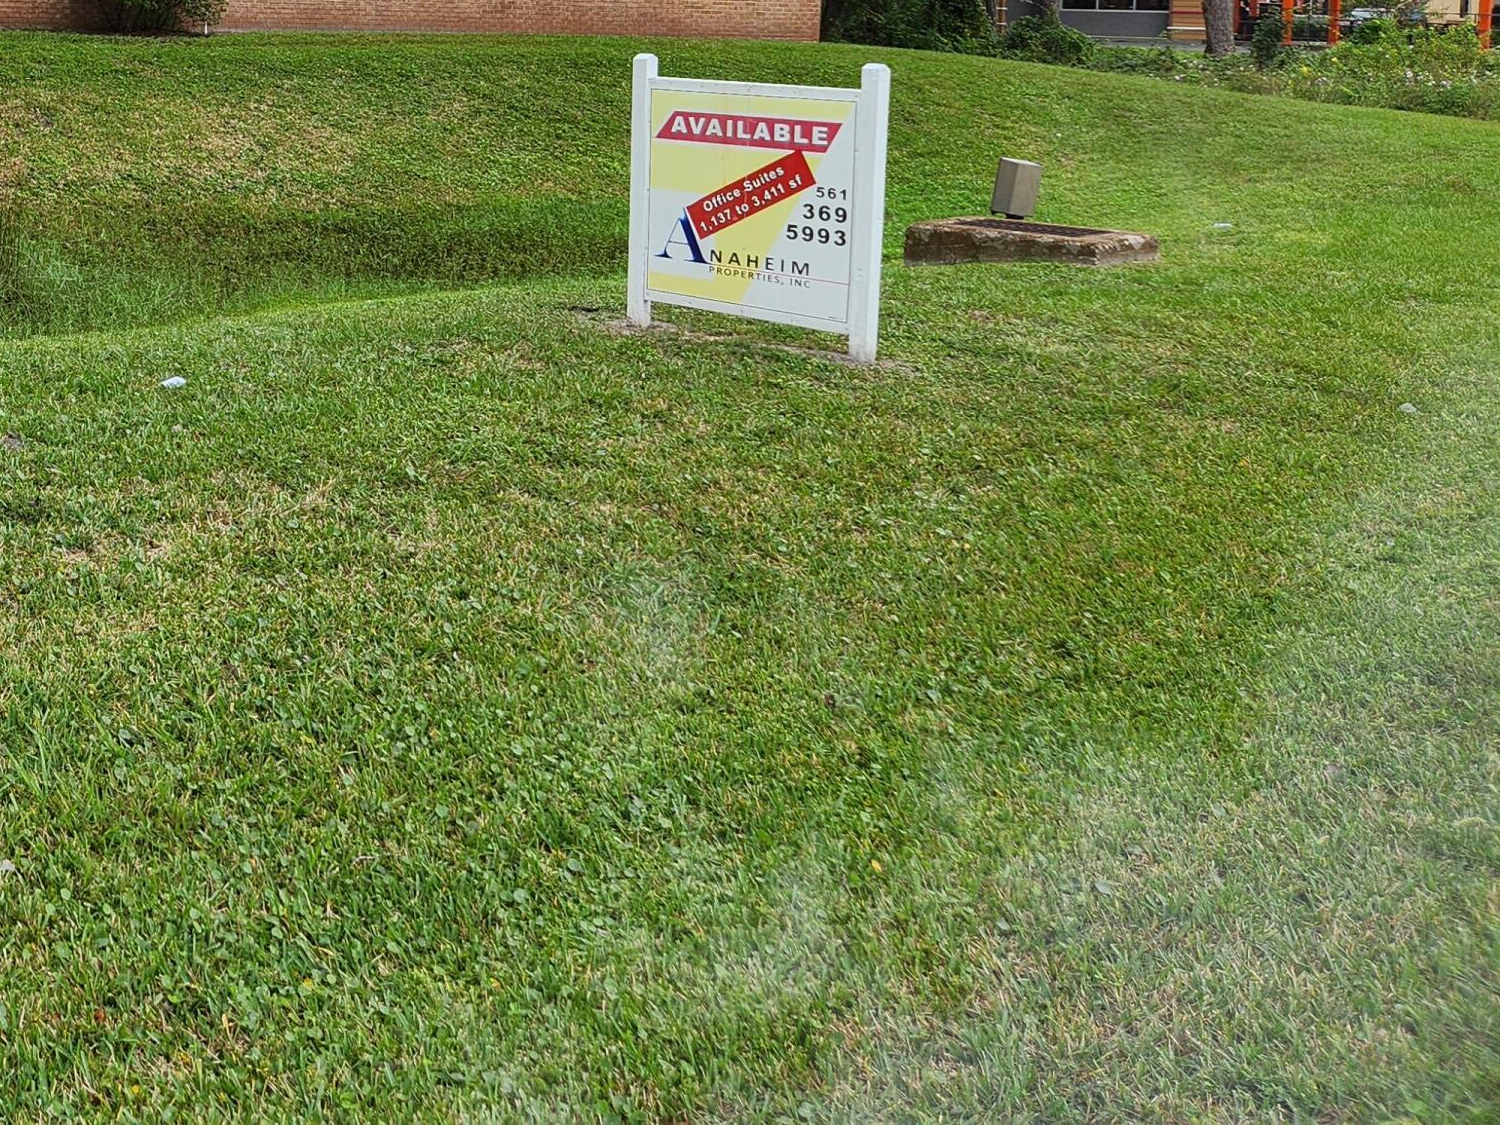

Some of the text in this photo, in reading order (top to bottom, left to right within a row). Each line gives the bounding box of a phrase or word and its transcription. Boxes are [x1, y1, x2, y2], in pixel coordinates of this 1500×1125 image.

[671, 116, 829, 145] AVAILABLE
[703, 166, 785, 212] Office Suites
[816, 186, 847, 201] 561
[700, 174, 803, 232] 1,137 to 3,411 sf
[802, 203, 847, 224] 369
[786, 224, 847, 247] 5993
[790, 278, 812, 289] INC
